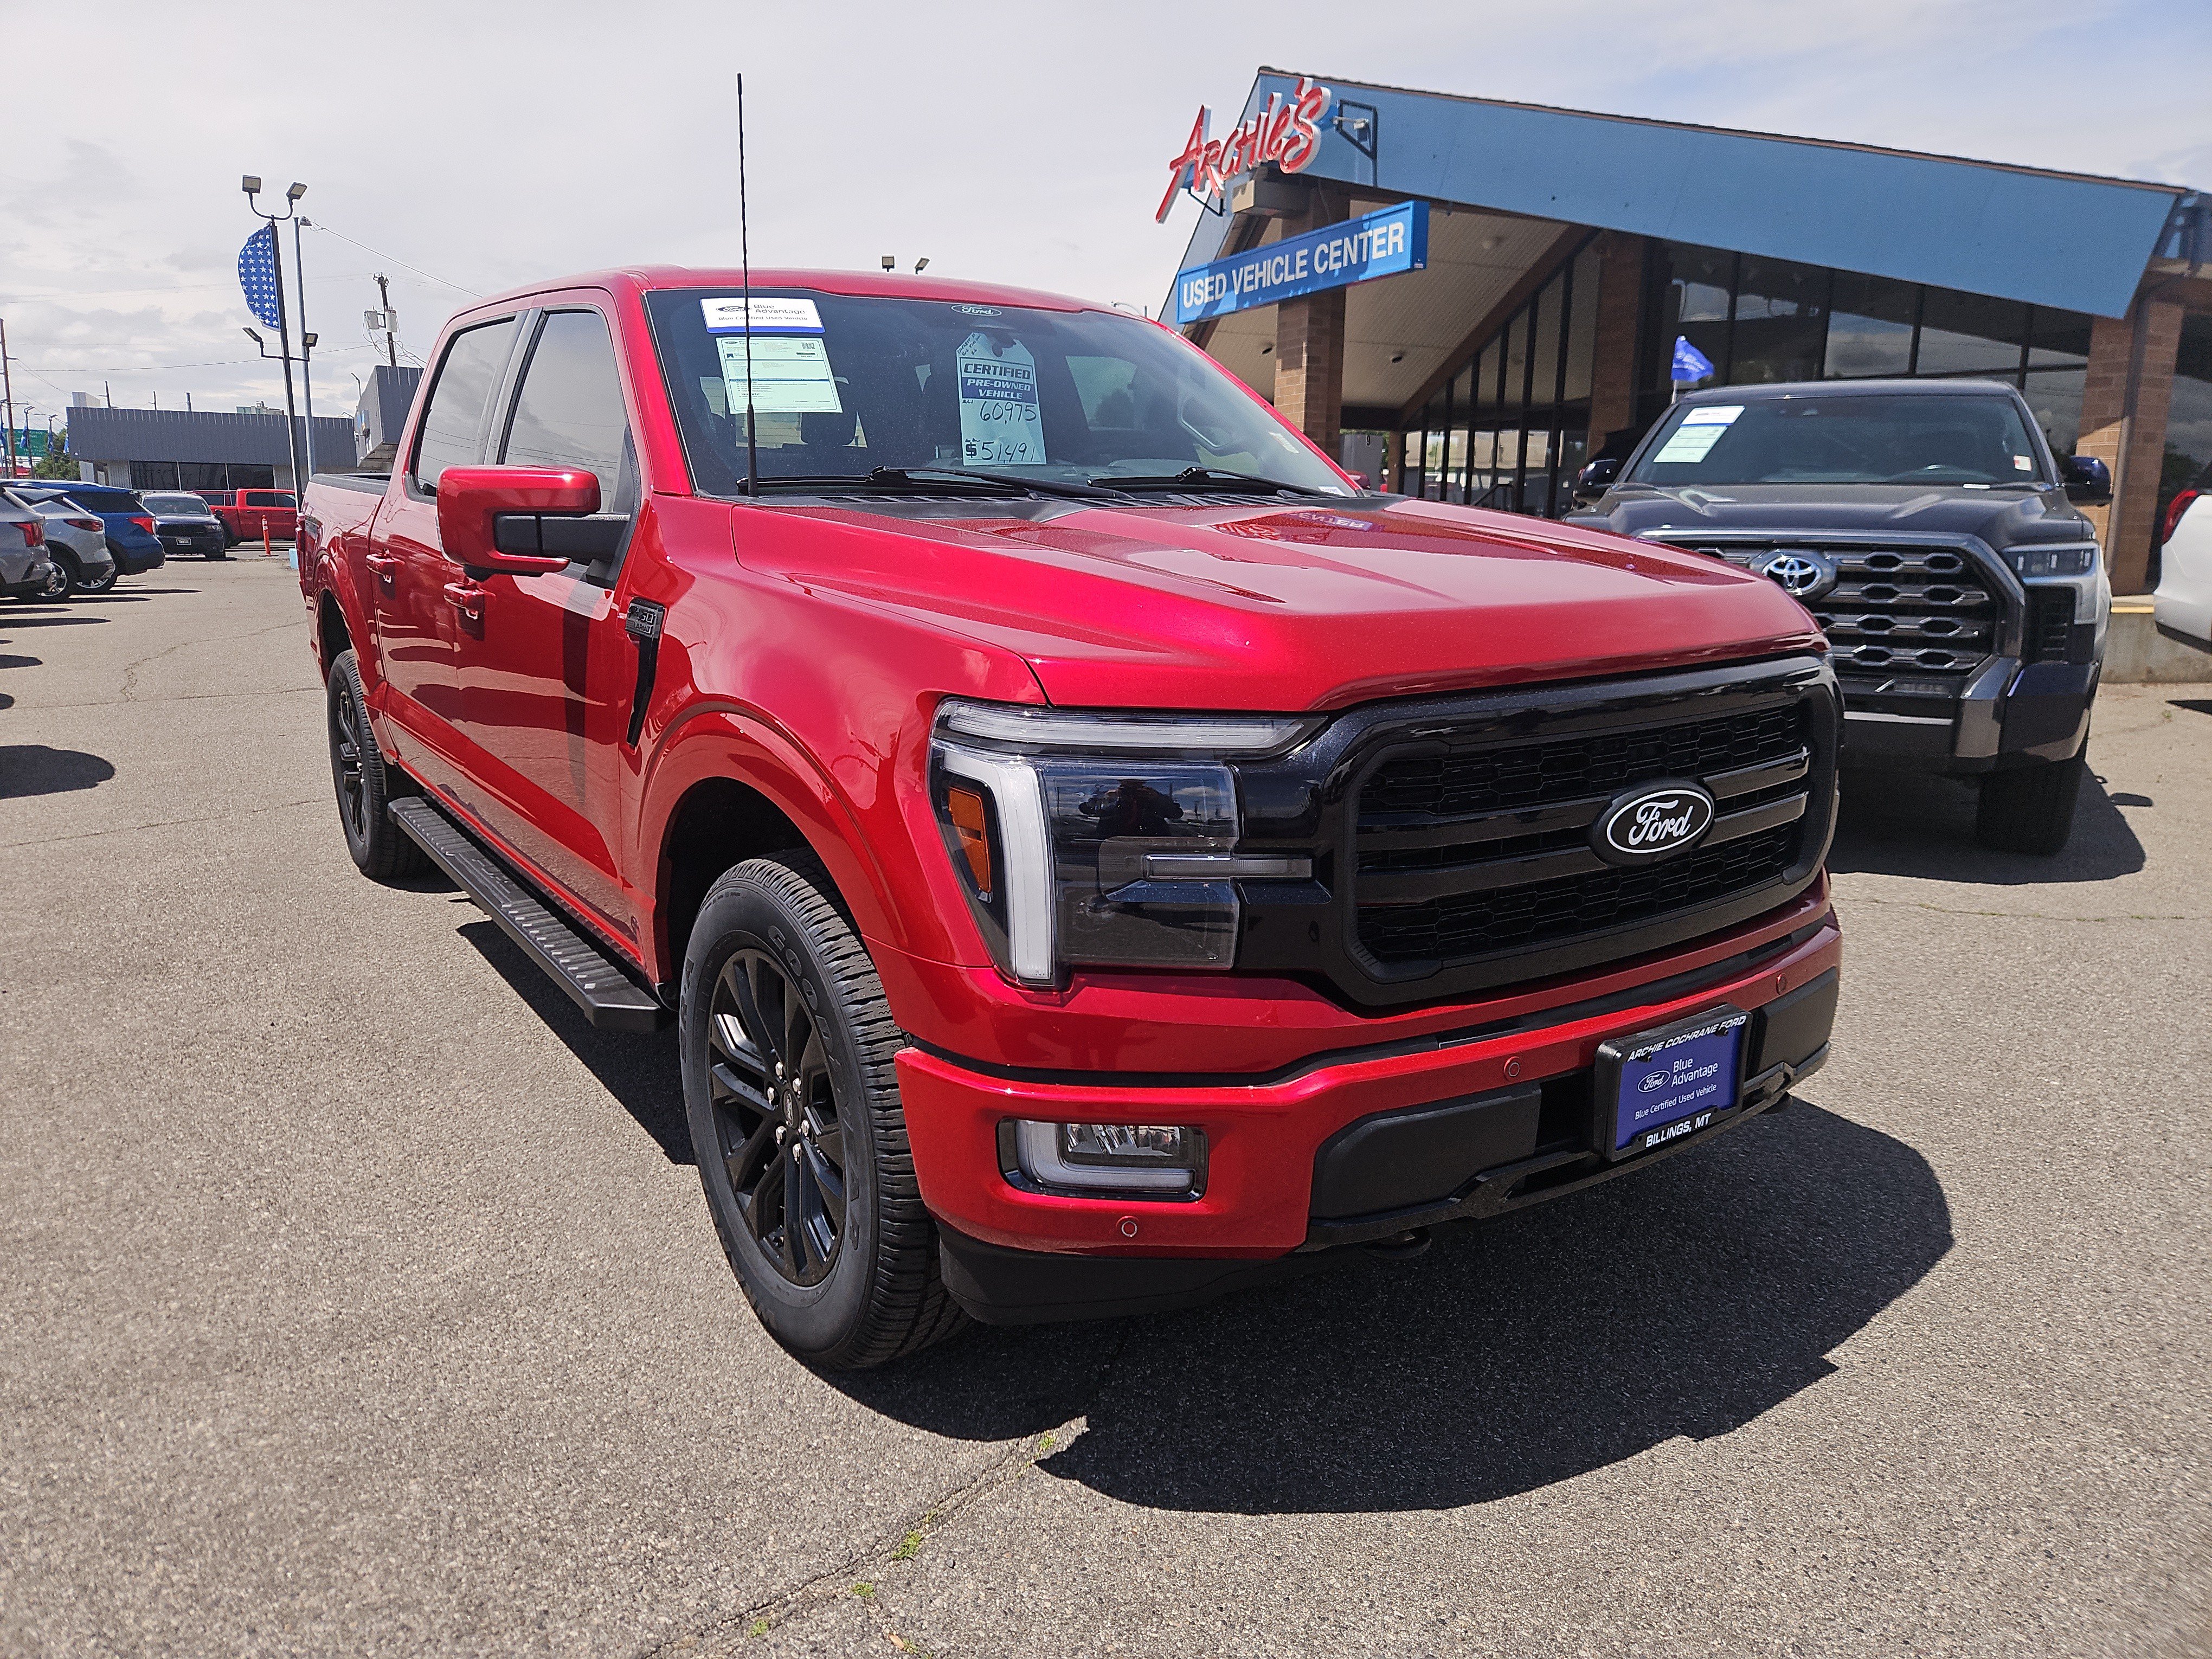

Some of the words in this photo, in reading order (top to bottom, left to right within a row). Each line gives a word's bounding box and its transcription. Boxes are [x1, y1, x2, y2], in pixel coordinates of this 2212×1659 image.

[1182, 273, 1227, 309] USED
[1232, 249, 1309, 295] VEHICLE
[1314, 221, 1405, 275] CENTER
[961, 305, 995, 315] Ford
[963, 363, 1031, 380] CERTIFIED
[967, 378, 1031, 391] PRE-OWNED
[978, 389, 1023, 400] VEHICLE
[980, 401, 1037, 425] 60,975
[1628, 799, 1694, 846] Ford
[1627, 1041, 1665, 1063] ARCHIE
[1664, 1023, 1720, 1049] COCHRANE
[1718, 1015, 1747, 1032] FORD
[1671, 1063, 1719, 1088] Advantage
[1673, 1058, 1693, 1073] Blue
[1635, 1107, 1649, 1121] Blue
[1650, 1098, 1677, 1114] Certified
[1678, 1090, 1694, 1104] Used
[1695, 1083, 1717, 1099] Vehicle
[1645, 1119, 1692, 1148] BILLINGS,
[1694, 1113, 1712, 1129] MT
